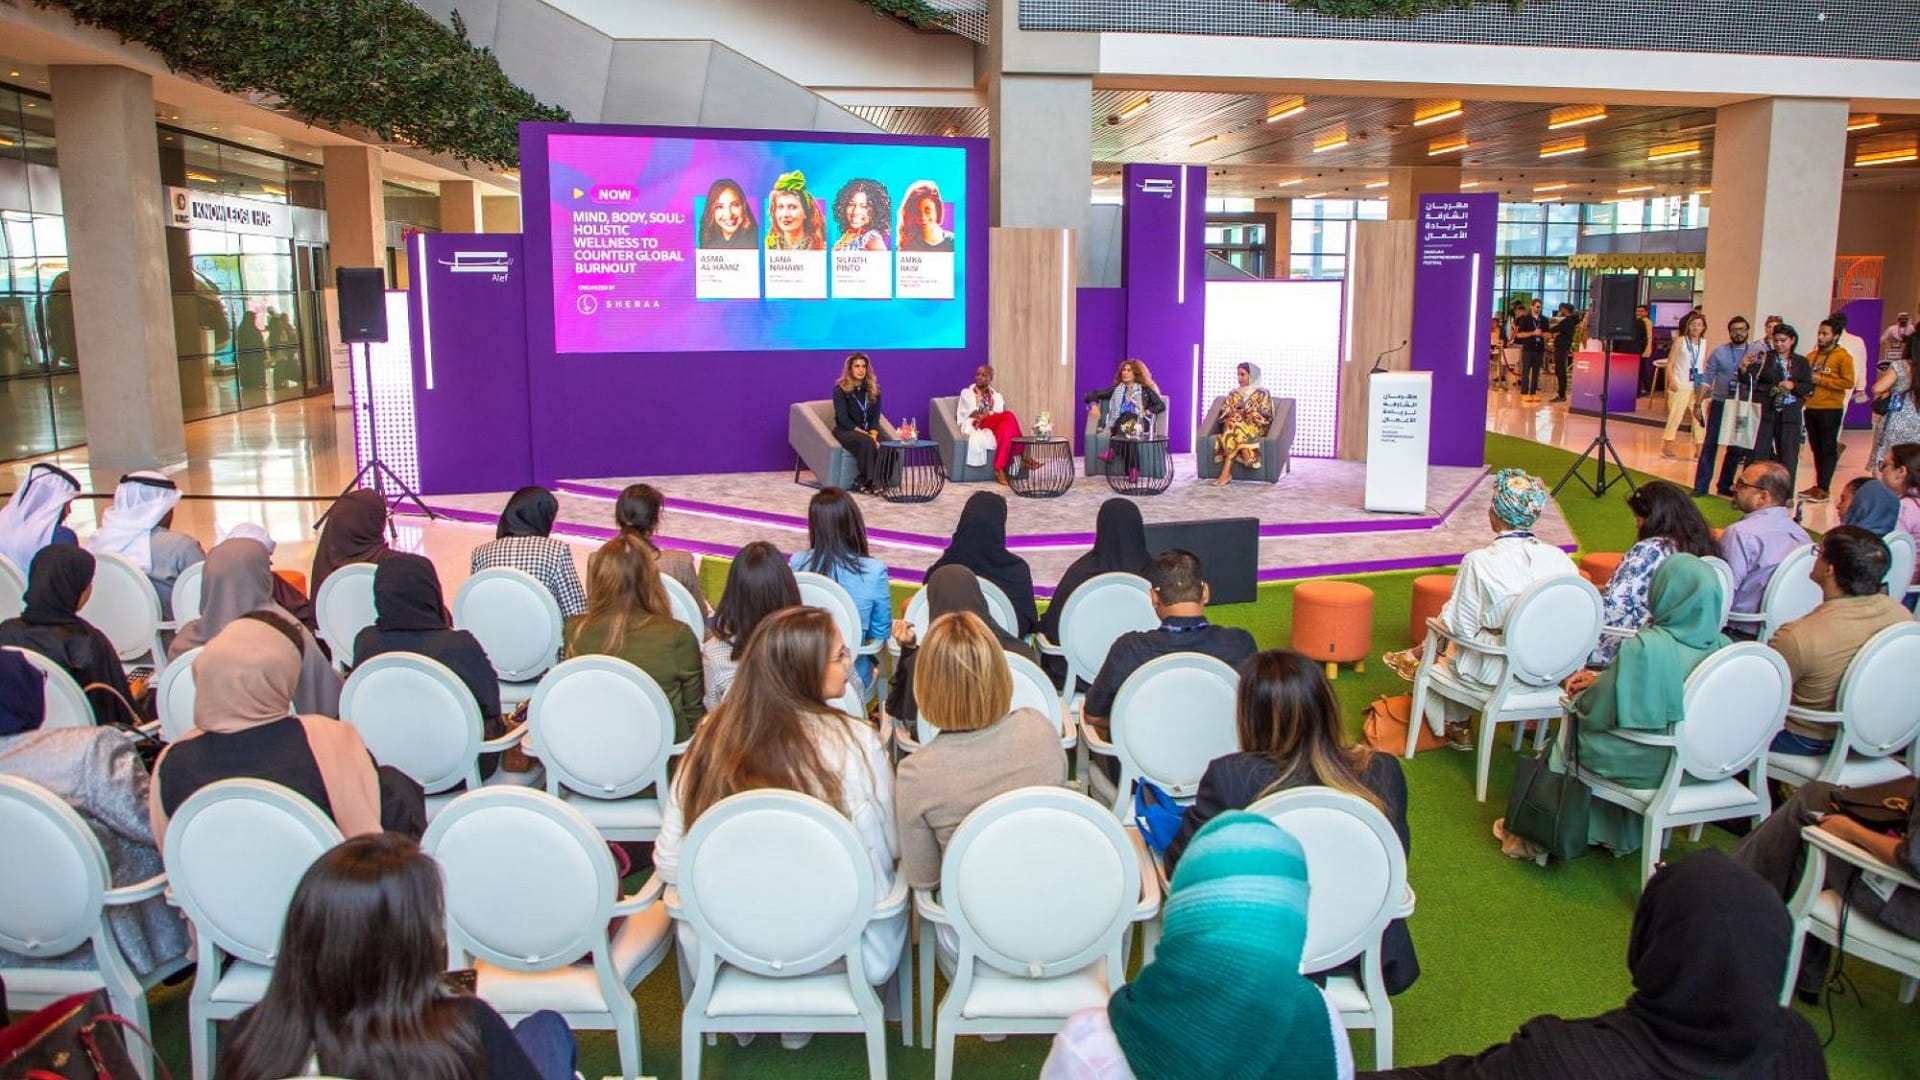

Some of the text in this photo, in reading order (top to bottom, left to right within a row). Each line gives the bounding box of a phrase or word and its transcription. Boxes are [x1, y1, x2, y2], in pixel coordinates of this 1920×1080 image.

[599, 189, 631, 200] NOW
[573, 211, 685, 225] MIND, BODY, SOUL:
[573, 224, 630, 235] HOLISTIC
[574, 237, 658, 248] WELLNESS TO
[574, 250, 684, 261] COUNTER GLOBAL
[700, 255, 724, 263] ASMA
[769, 256, 792, 264] LANA
[575, 262, 637, 273] BURNOUT
[836, 264, 861, 272] PINTO
[492, 273, 508, 283] Alef
[606, 300, 660, 308] SHERAA
